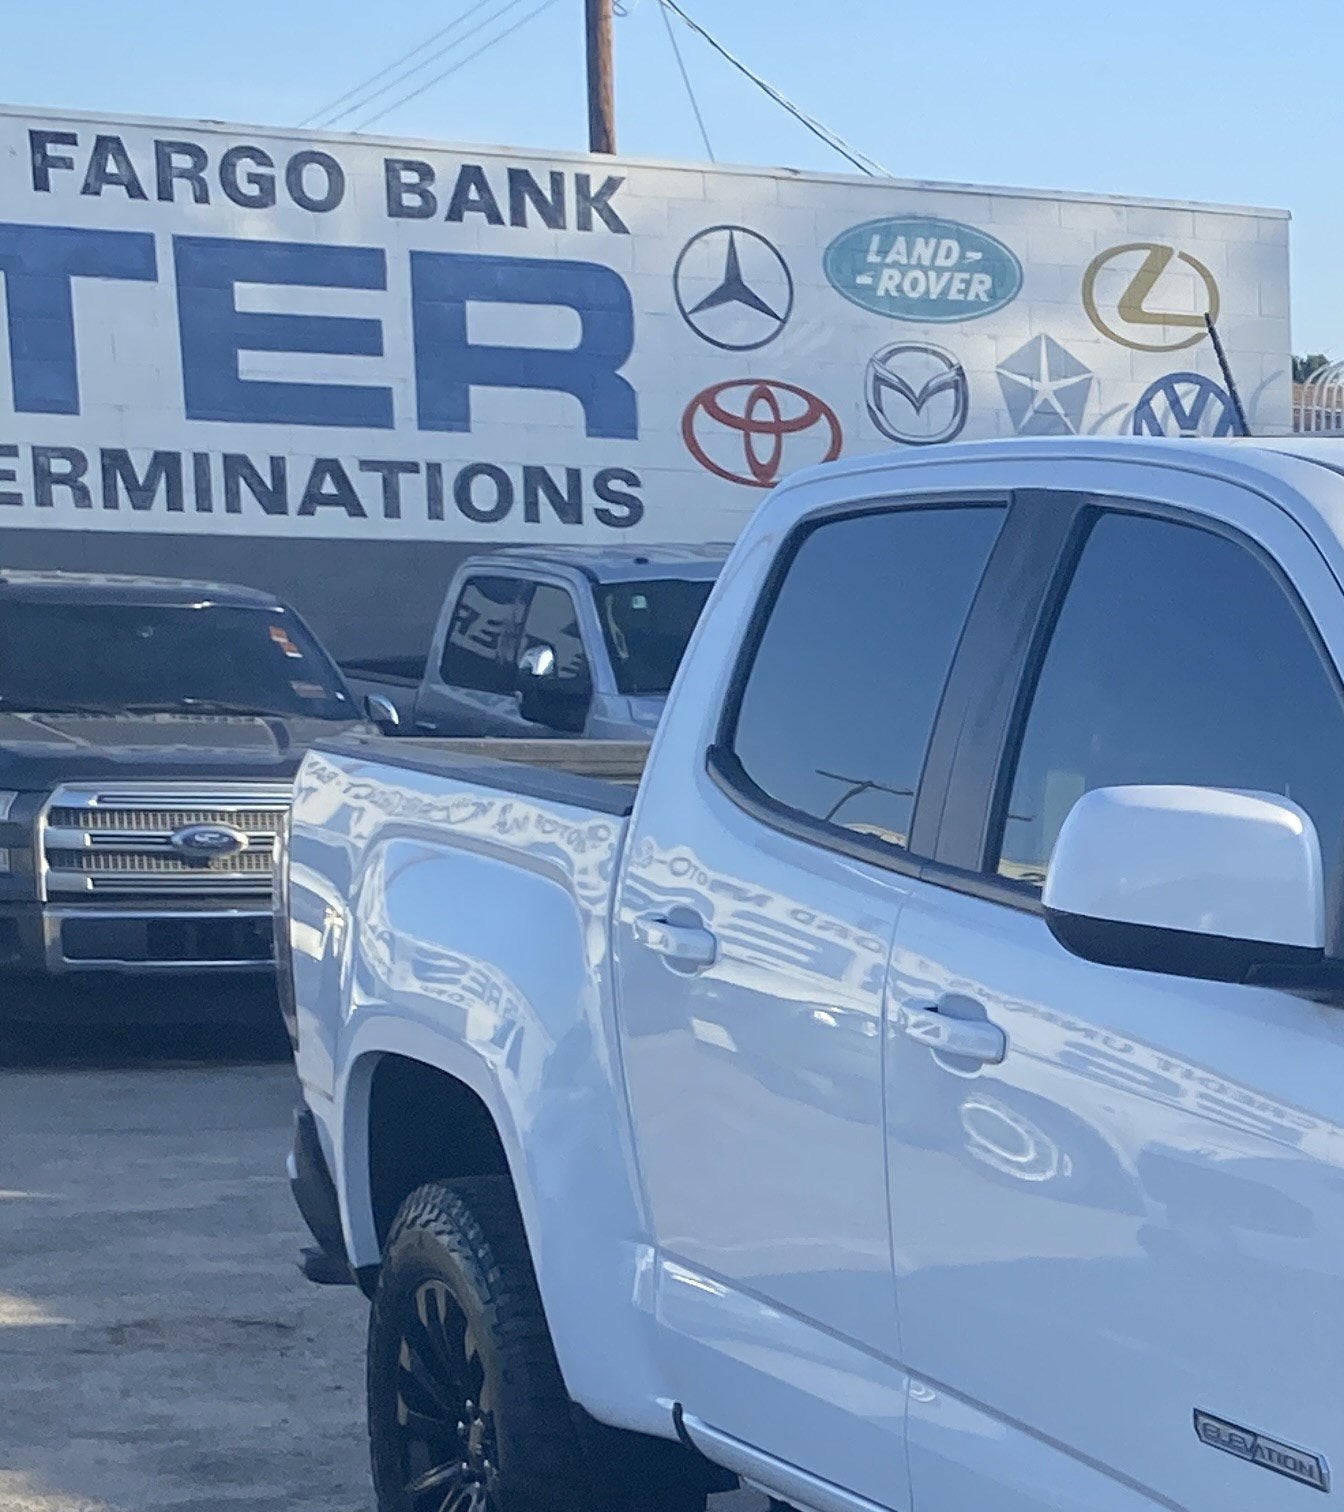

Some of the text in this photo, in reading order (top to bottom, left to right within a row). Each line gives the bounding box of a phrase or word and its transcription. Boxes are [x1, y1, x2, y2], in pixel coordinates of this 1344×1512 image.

[28, 129, 631, 235] FARGO BANK
[0, 222, 639, 440] TER
